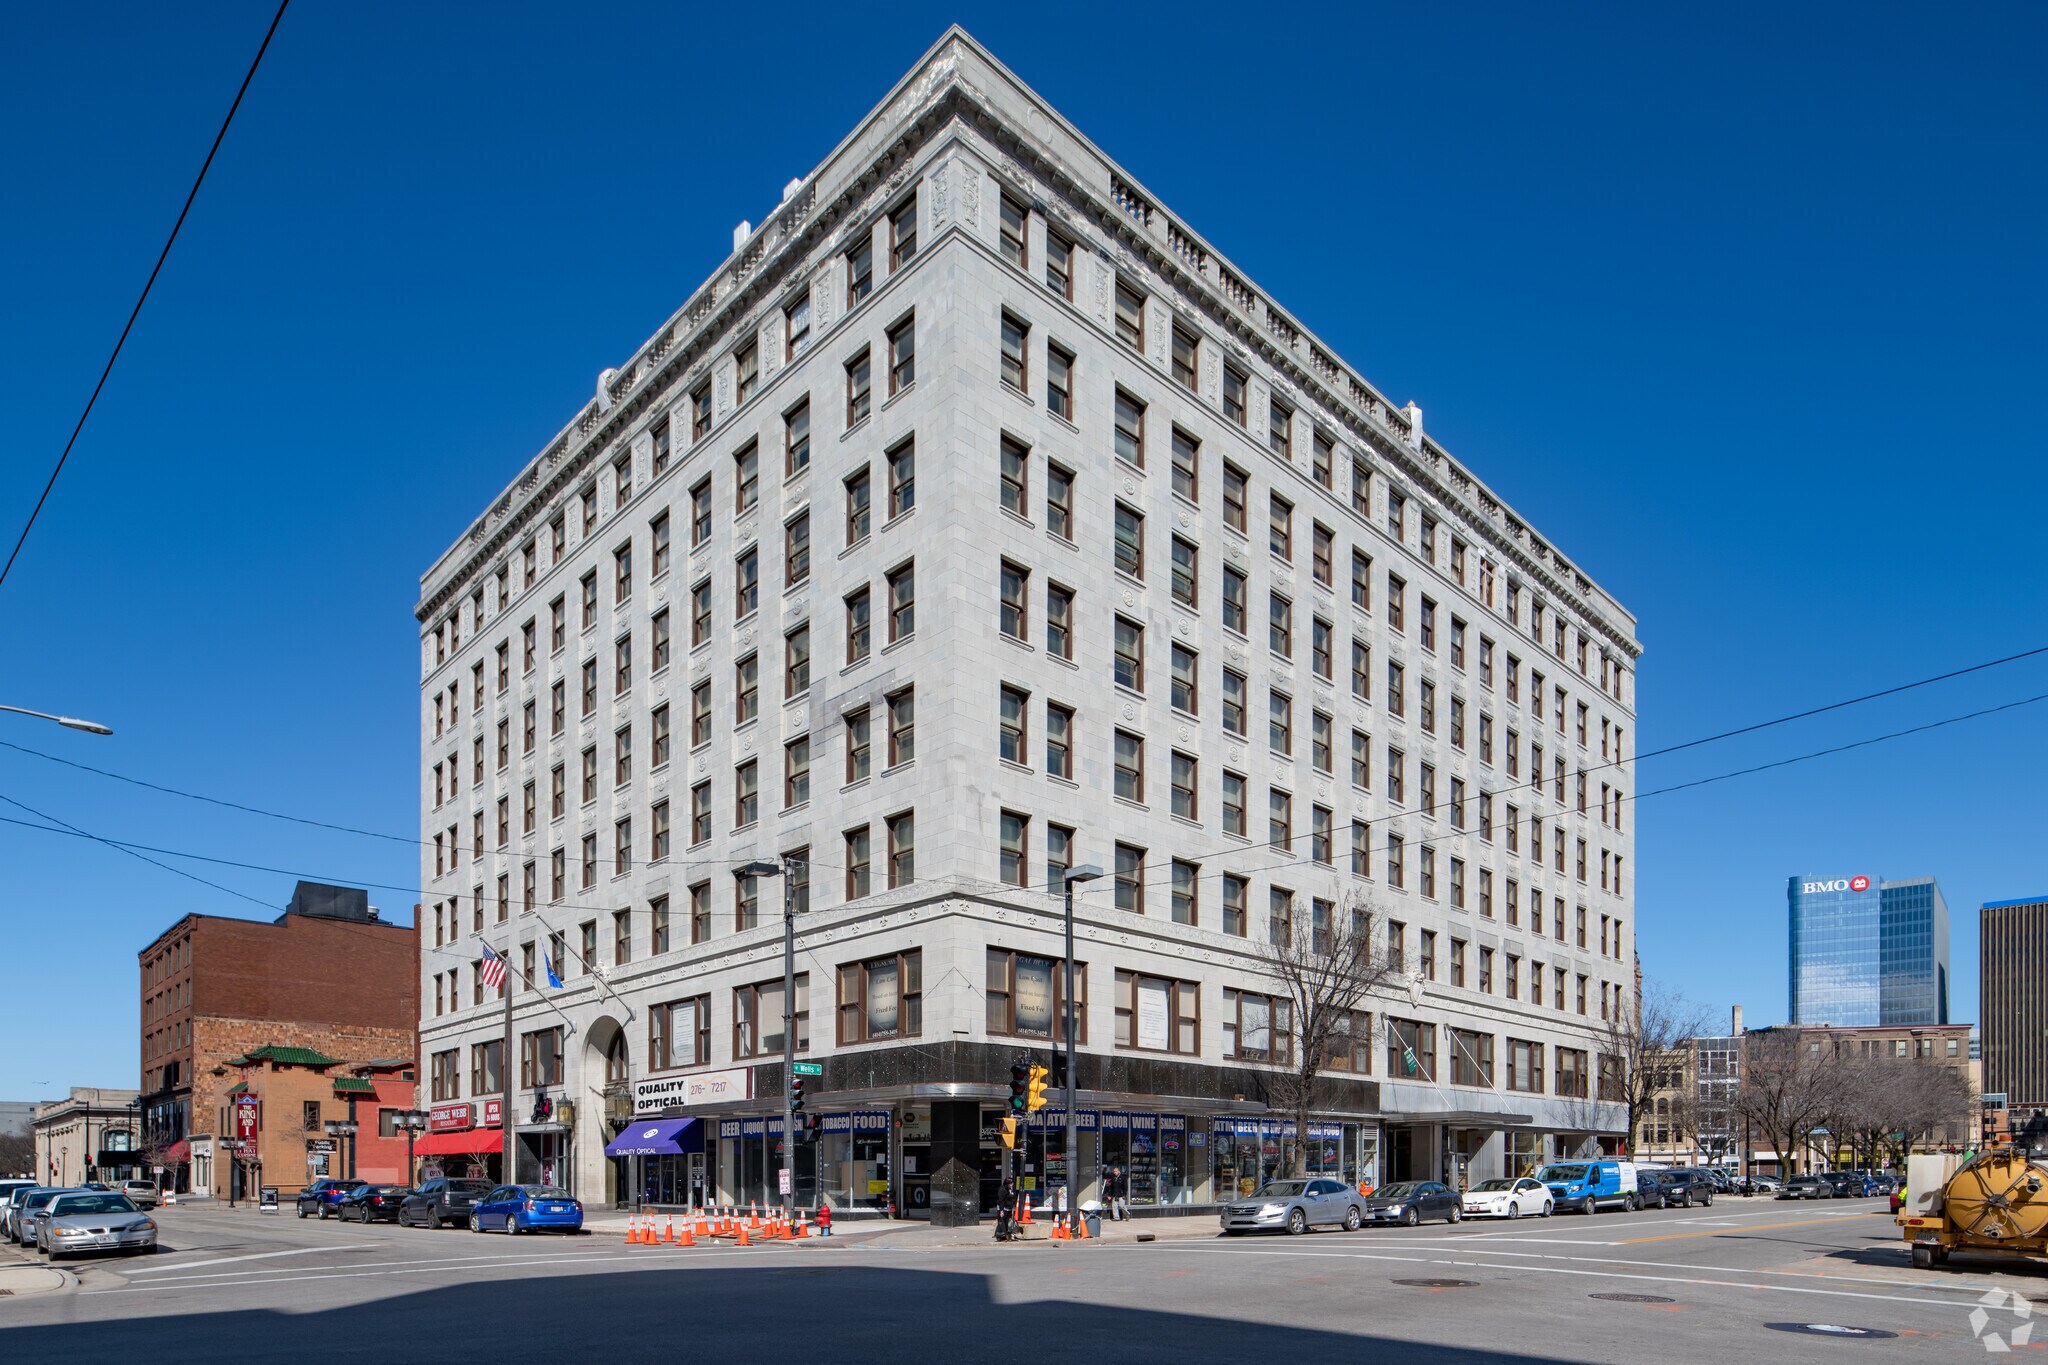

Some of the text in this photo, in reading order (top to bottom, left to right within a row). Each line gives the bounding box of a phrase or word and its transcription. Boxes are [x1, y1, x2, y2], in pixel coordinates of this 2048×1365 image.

[1803, 880, 1849, 894] BMO
[800, 1065, 814, 1073] Wells
[638, 1081, 684, 1096] QUALITY
[711, 1082, 727, 1093] 7217
[638, 1096, 684, 1109] OPTICAL
[239, 1109, 256, 1119] KING
[432, 1107, 467, 1121] GEORGE WEBB
[721, 1121, 740, 1136] BEER
[768, 1120, 784, 1133] WIN
[822, 1116, 850, 1130] TOBACCO
[853, 1115, 886, 1129] FOOD
[1075, 1114, 1096, 1127] BEER
[1102, 1115, 1128, 1129] LIQUOR
[1132, 1117, 1156, 1129] WINE
[1161, 1118, 1185, 1130] SNACKS
[1214, 1120, 1234, 1132] ATM
[1237, 1121, 1258, 1133] BEER
